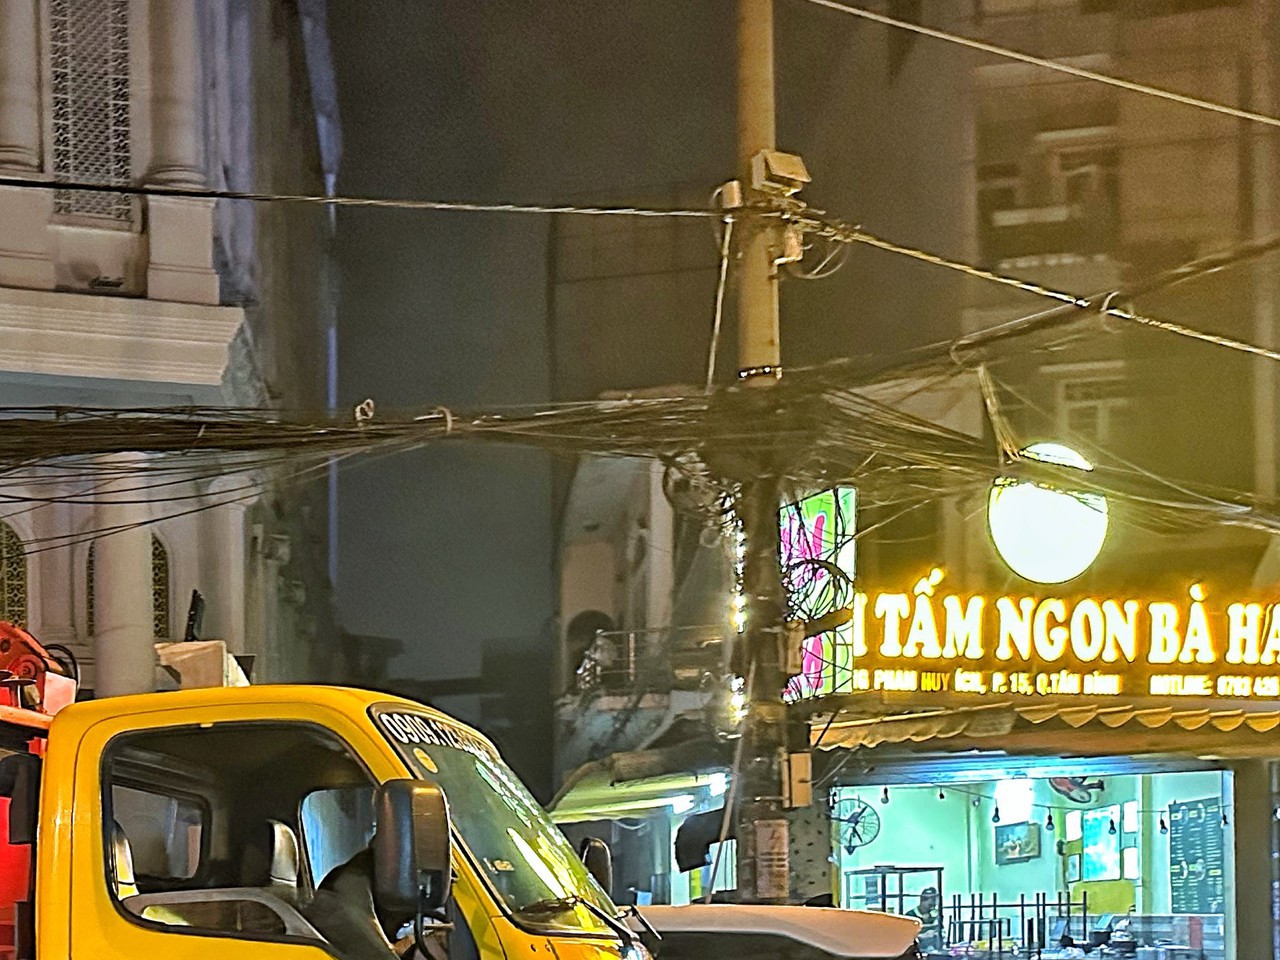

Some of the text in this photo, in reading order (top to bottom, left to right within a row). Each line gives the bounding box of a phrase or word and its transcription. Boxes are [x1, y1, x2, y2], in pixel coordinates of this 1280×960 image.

[875, 567, 984, 659] TẤM
[995, 596, 1139, 662] NGON
[1147, 583, 1216, 664] BÀ
[921, 672, 950, 692] HUY
